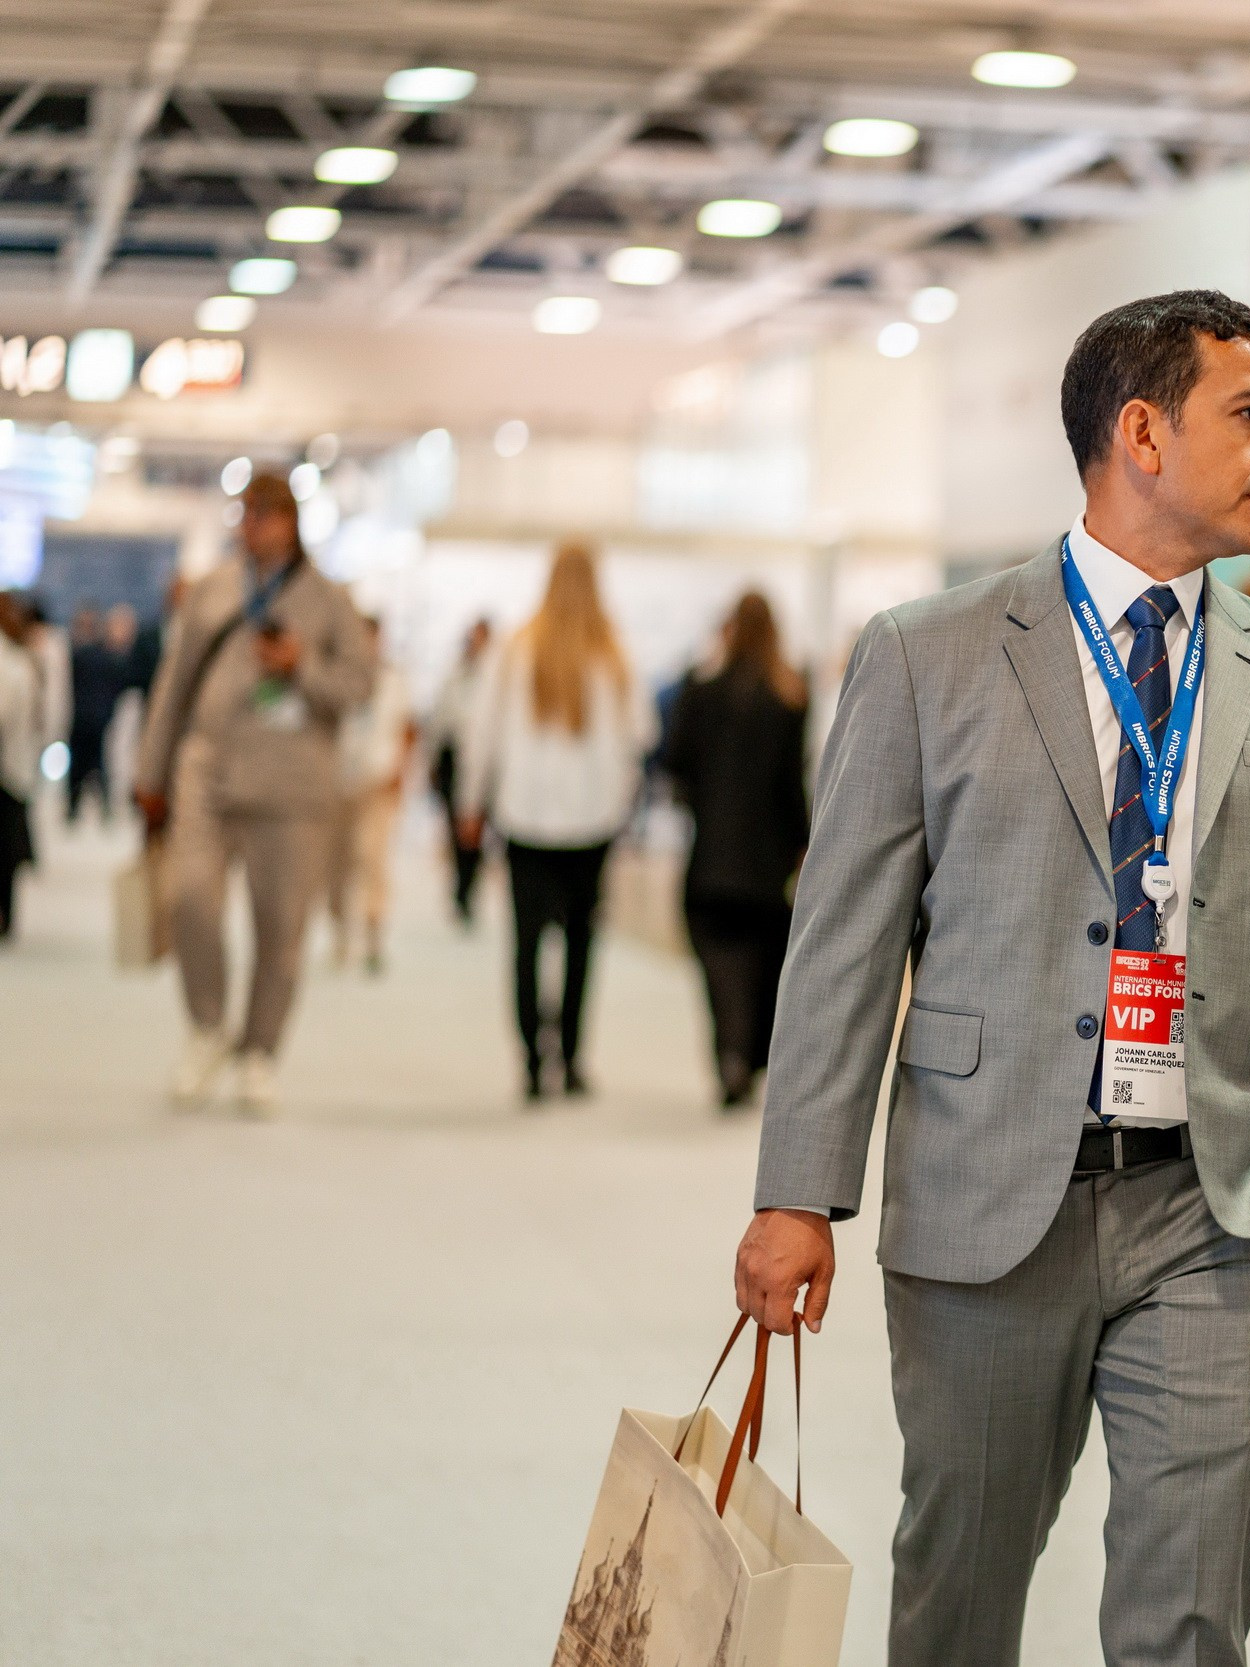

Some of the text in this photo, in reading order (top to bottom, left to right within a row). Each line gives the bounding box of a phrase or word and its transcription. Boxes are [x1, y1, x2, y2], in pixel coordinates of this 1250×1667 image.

[1078, 600, 1121, 680] IMBRICS FORUM
[1183, 648, 1201, 691] IMBRICS
[1131, 722, 1155, 769] IMBRICS
[1158, 729, 1182, 815] IMBRICS FORUM
[1113, 982, 1152, 997] BRICS
[1114, 975, 1166, 986] INTERNATIONAL
[1112, 1005, 1156, 1031] VIP
[1114, 1047, 1177, 1059] JOHANN CARLOS
[1114, 1056, 1185, 1068] ALVAREZ MARQUEZ
